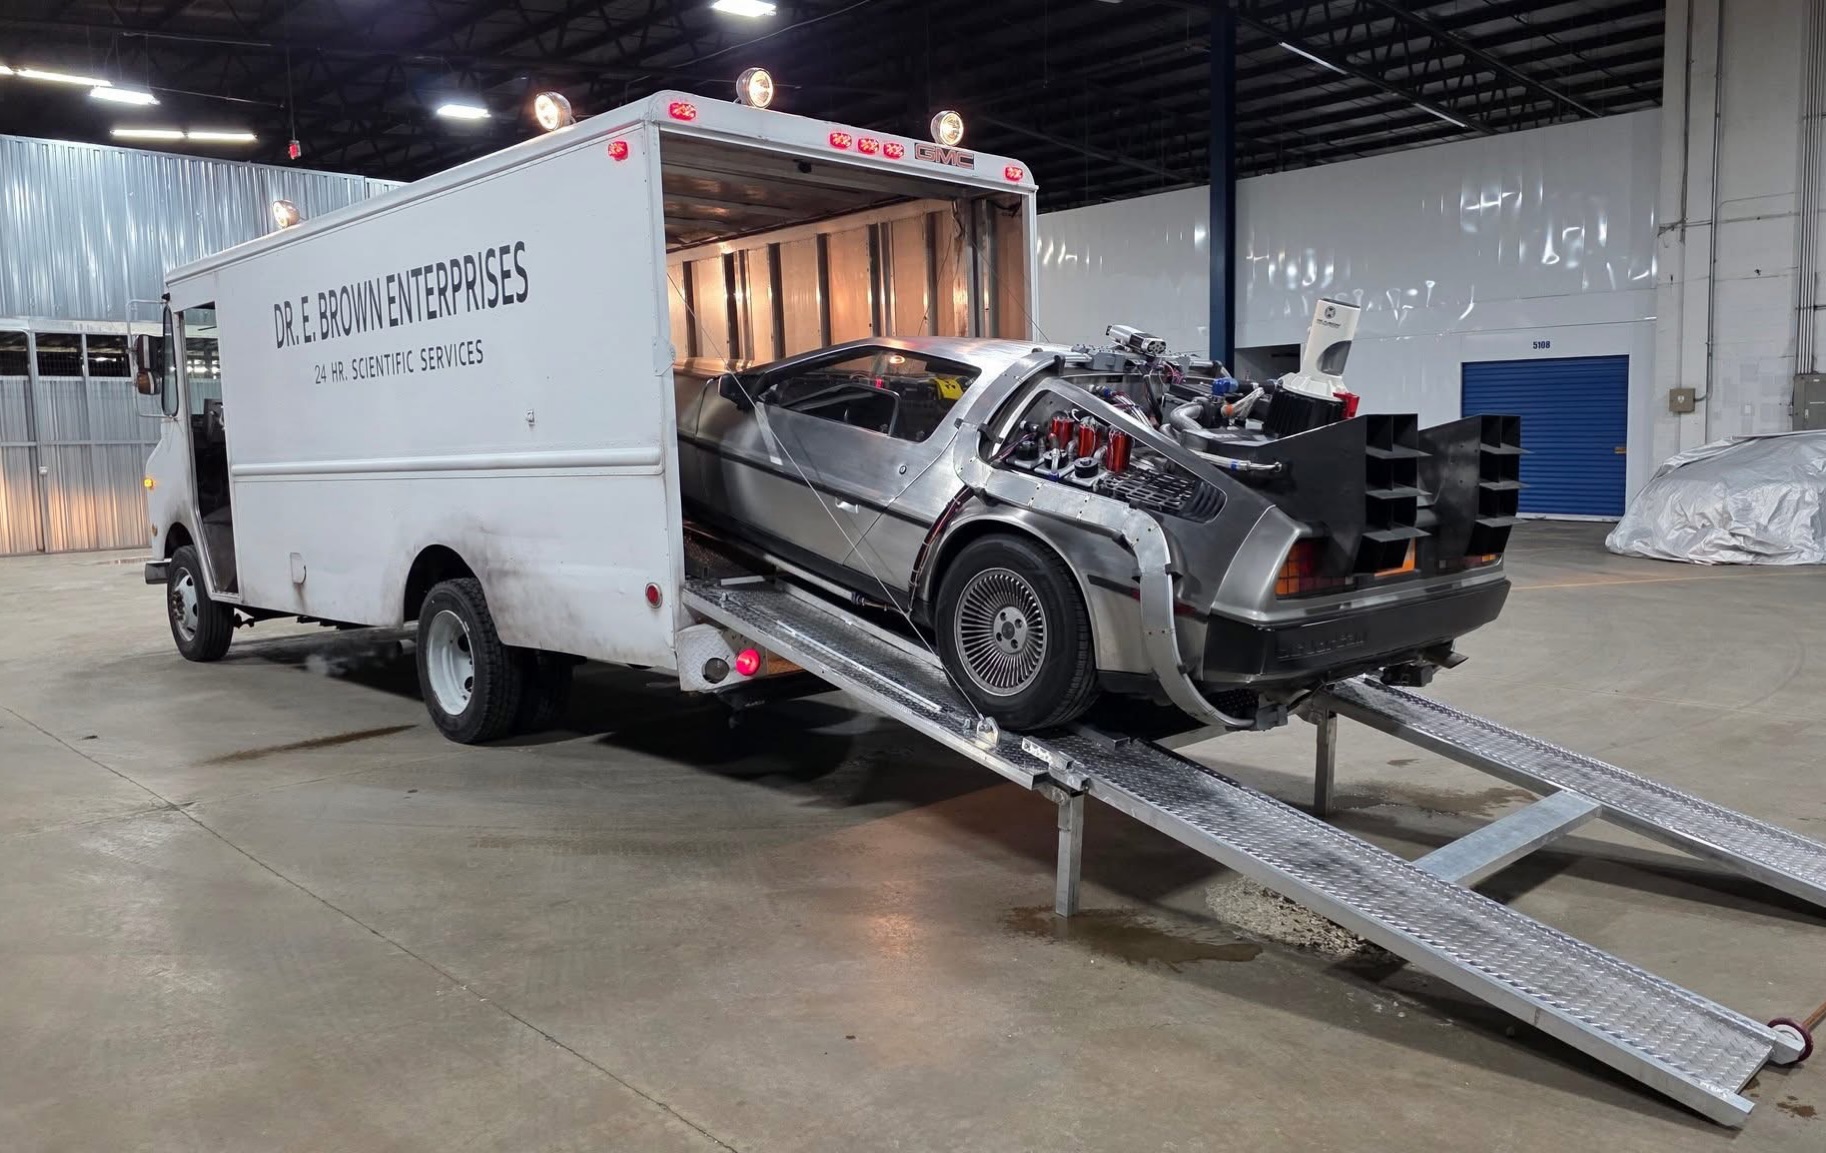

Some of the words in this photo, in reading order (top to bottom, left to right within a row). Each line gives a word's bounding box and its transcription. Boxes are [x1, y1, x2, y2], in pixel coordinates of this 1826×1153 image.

[915, 143, 974, 169] GMC
[274, 300, 299, 348] DR.
[302, 295, 316, 344] E.
[318, 277, 383, 341] BROWN
[386, 241, 529, 327] ENTERPRISES
[315, 364, 327, 384] 24
[331, 361, 348, 383] HR.
[351, 350, 414, 380] SCIENTIFIC
[421, 339, 484, 371] SERVICES
[1533, 341, 1550, 349] 5108
